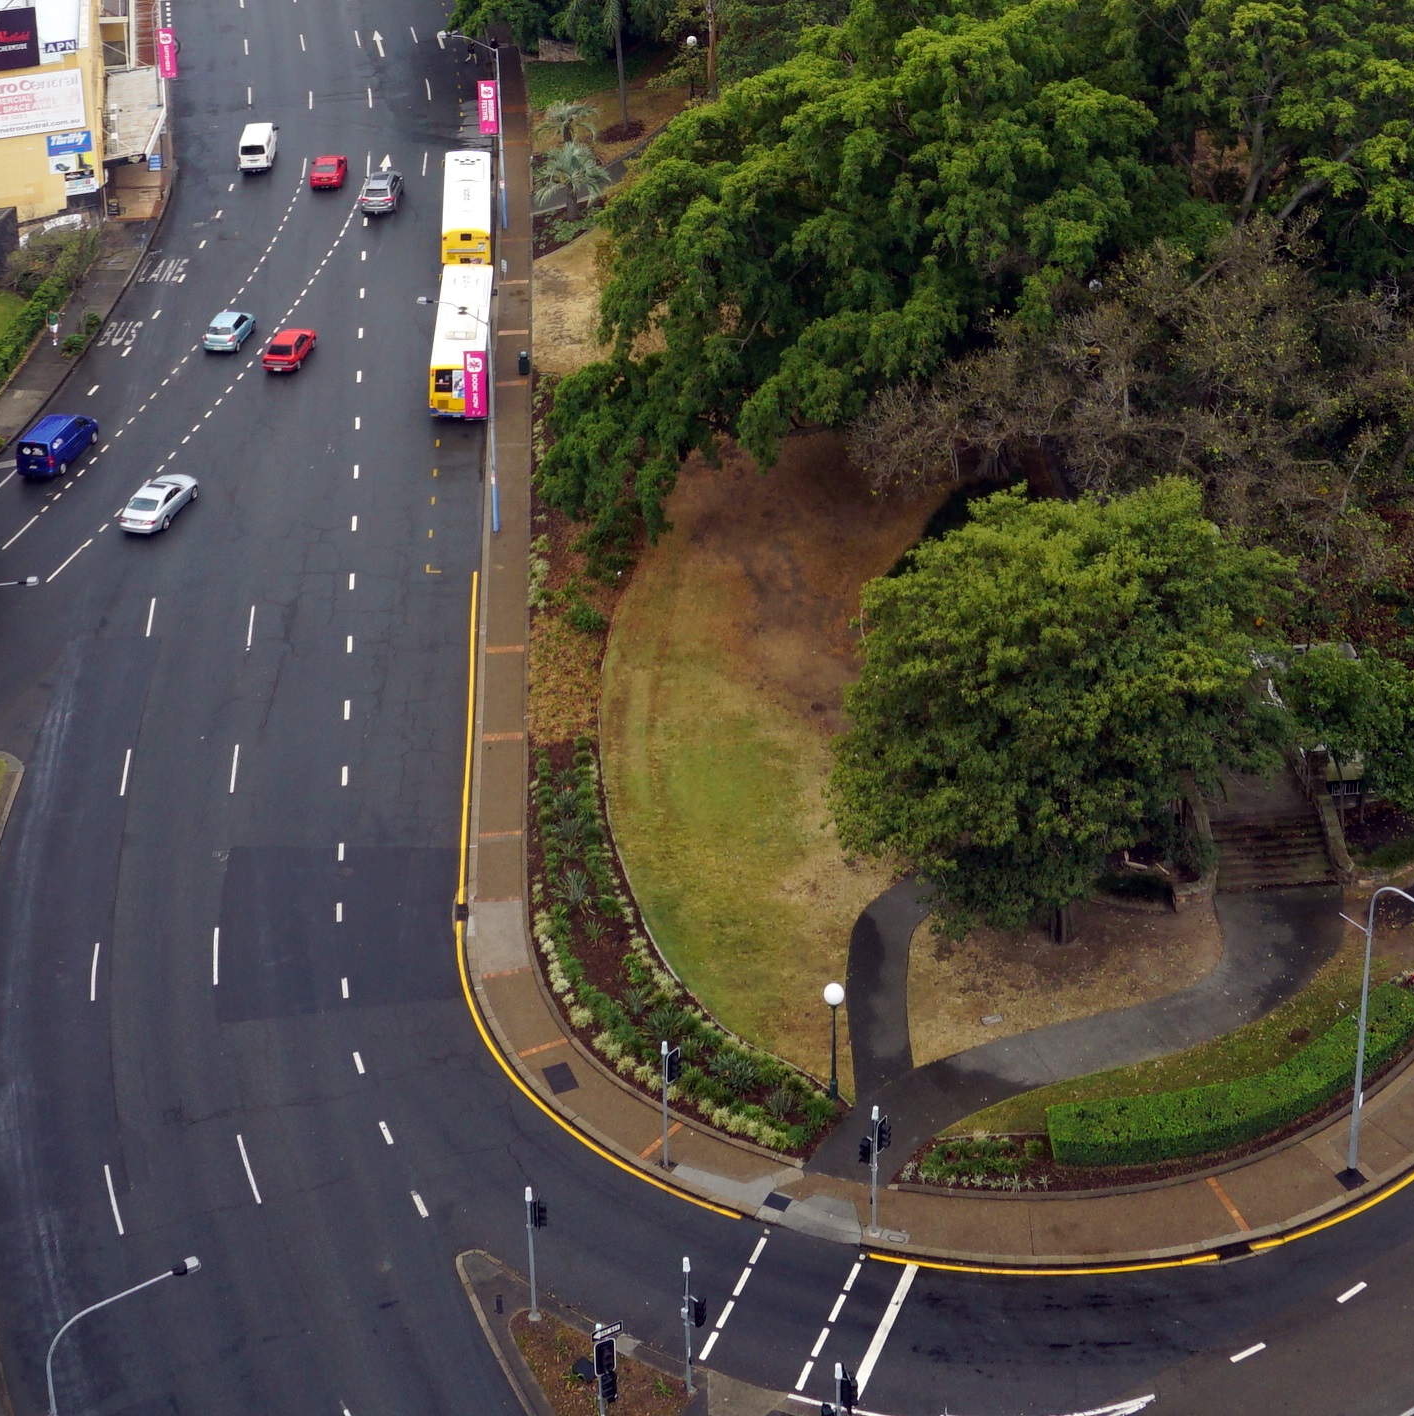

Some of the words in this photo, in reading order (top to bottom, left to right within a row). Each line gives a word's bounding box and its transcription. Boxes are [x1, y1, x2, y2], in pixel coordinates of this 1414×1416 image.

[46, 40, 76, 53] APN
[19, 73, 78, 93] Central
[2, 103, 31, 114] SPACE
[137, 258, 189, 282] LANE
[96, 321, 143, 347] BUS
[471, 373, 479, 392] BOOK
